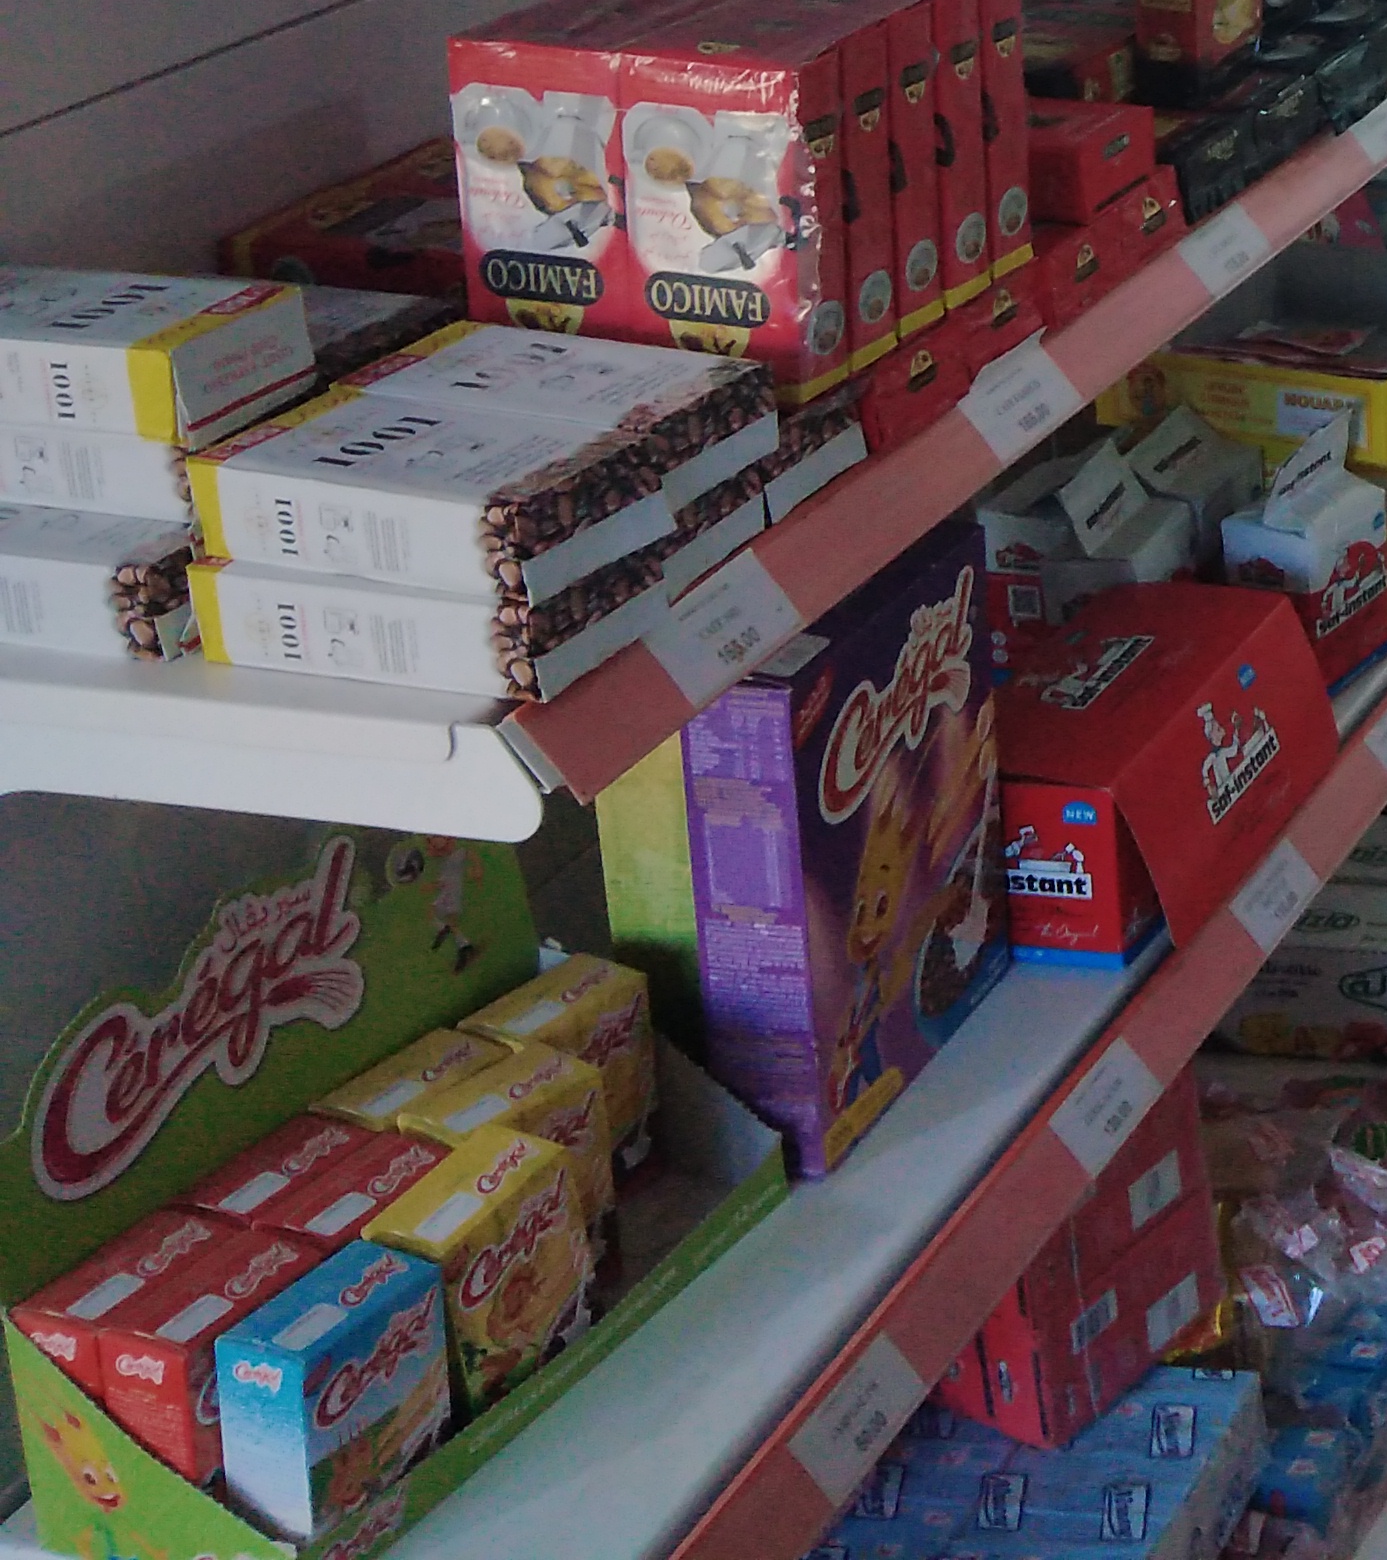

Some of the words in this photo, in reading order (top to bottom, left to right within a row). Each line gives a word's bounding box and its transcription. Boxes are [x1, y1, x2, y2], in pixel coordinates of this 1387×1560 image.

[50, 283, 170, 330] 1001
[486, 258, 598, 300] FAMICO
[650, 279, 764, 322] FAMICO
[50, 362, 76, 419] 1001
[313, 414, 441, 469] 1001
[273, 497, 299, 557] 1001
[277, 603, 303, 661] 1001
[1210, 734, 1279, 820] saf-instant
[1065, 808, 1094, 821] NEW
